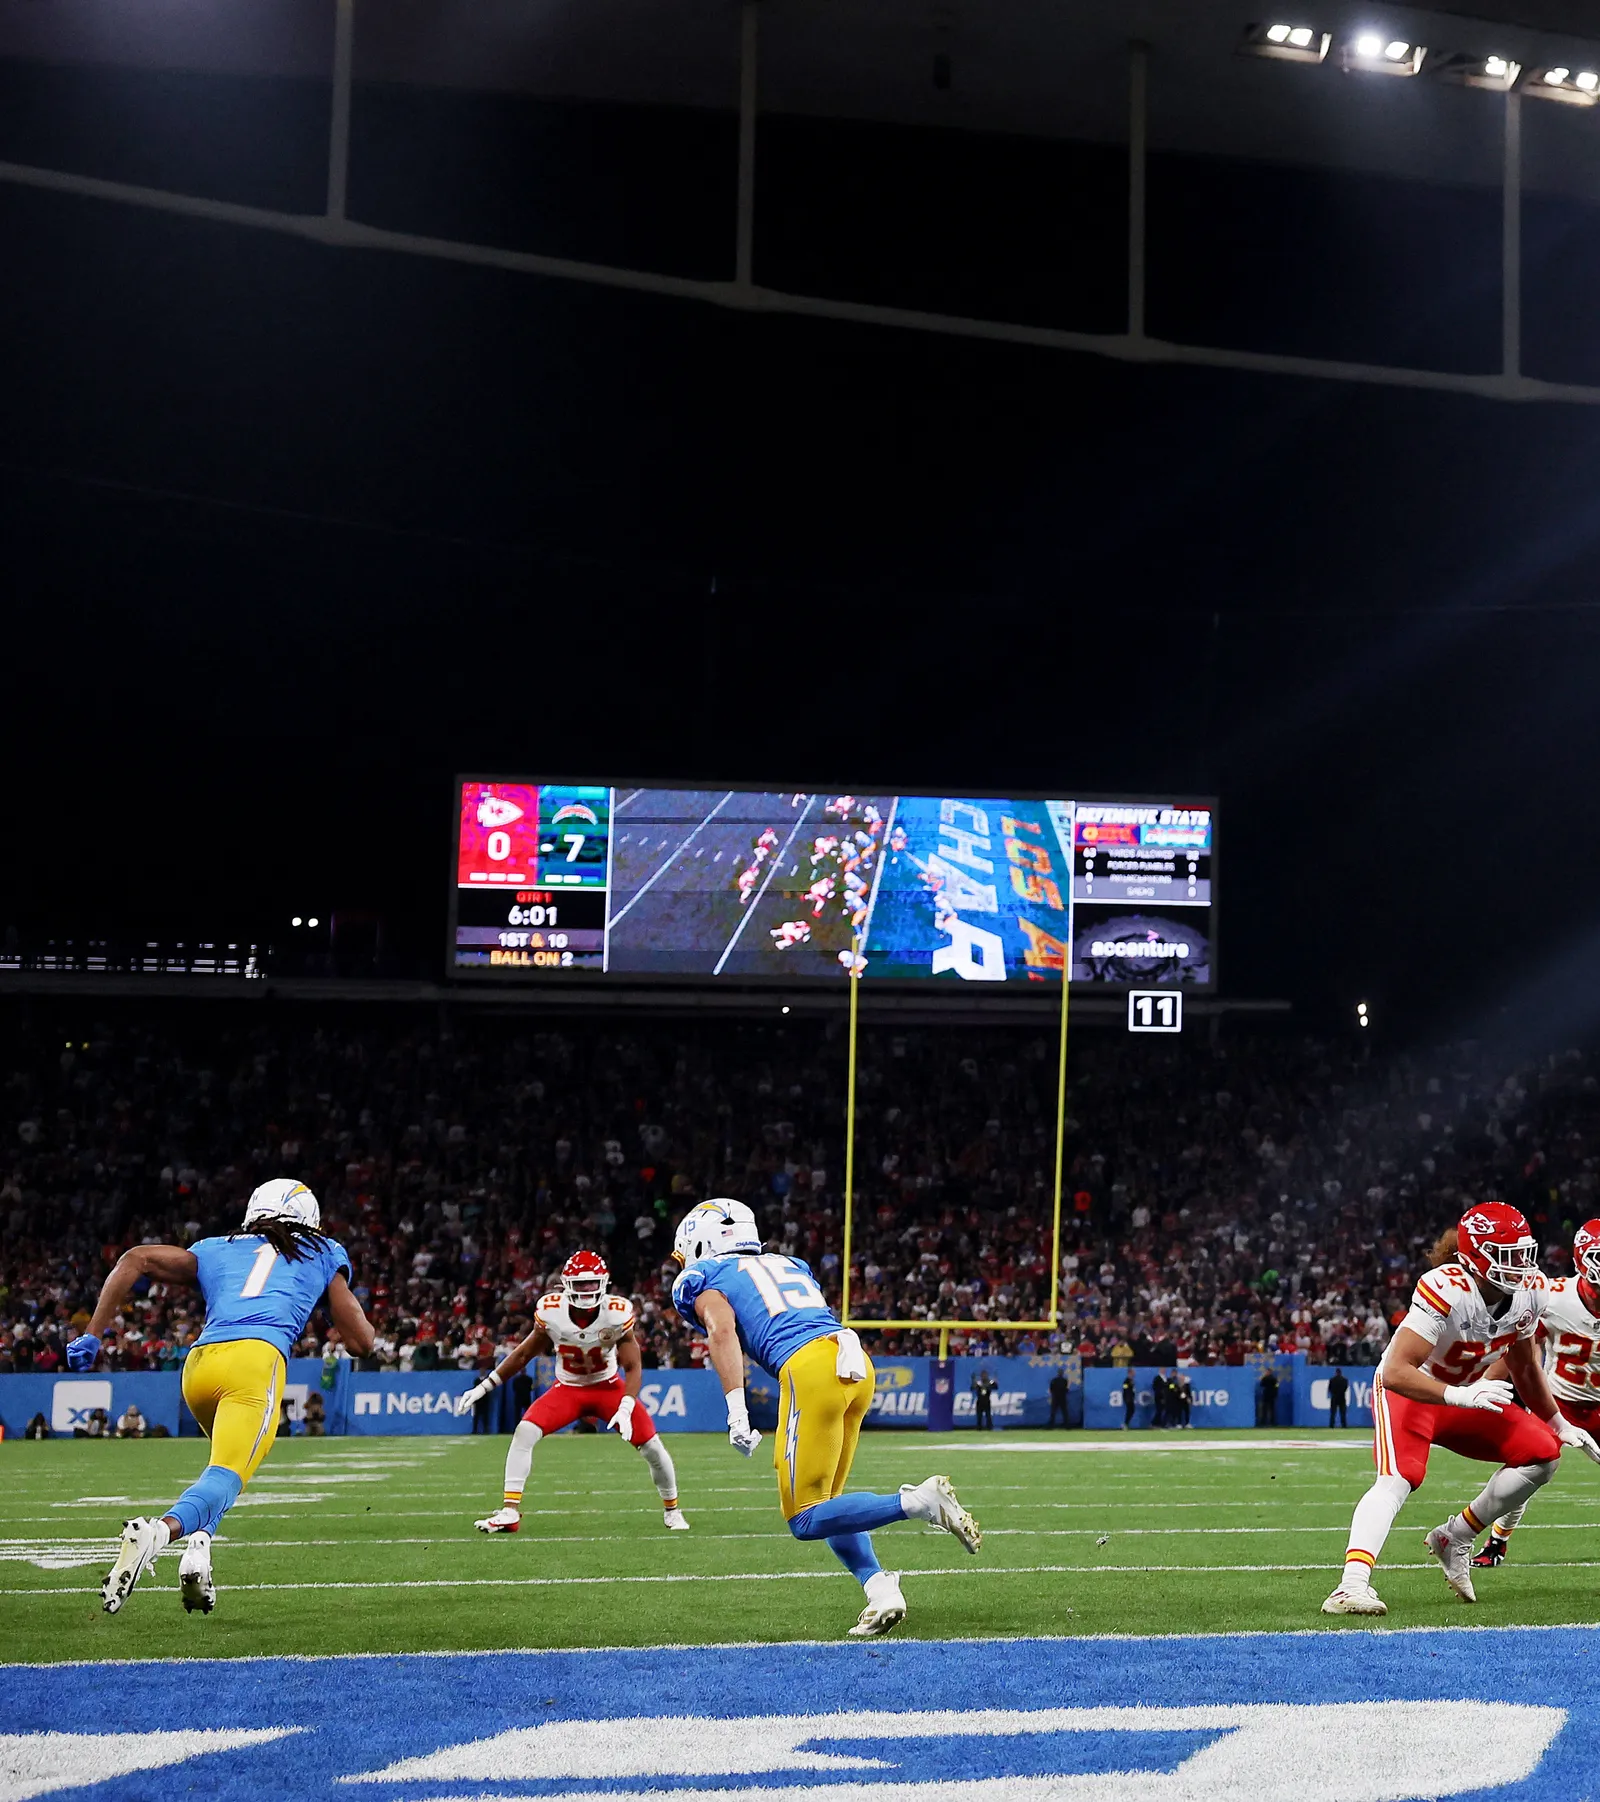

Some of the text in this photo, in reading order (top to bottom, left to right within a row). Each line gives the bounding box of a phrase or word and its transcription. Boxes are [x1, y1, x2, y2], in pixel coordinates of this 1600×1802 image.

[487, 831, 511, 861] 0
[563, 834, 585, 862] 7
[516, 891, 541, 903] QTR
[508, 905, 558, 926] 6:01
[499, 932, 530, 947] 1ST
[547, 933, 568, 949] 10
[1091, 940, 1189, 958] accenture
[490, 950, 574, 967] BALL ON 2
[1136, 997, 1173, 1025] 11
[684, 1219, 697, 1235] 15
[240, 1243, 279, 1298] 1
[1441, 1267, 1471, 1293] 97
[738, 1256, 827, 1318] 15
[559, 1344, 608, 1375] 21
[640, 1384, 687, 1416] SA
[953, 1391, 1027, 1416] GME
